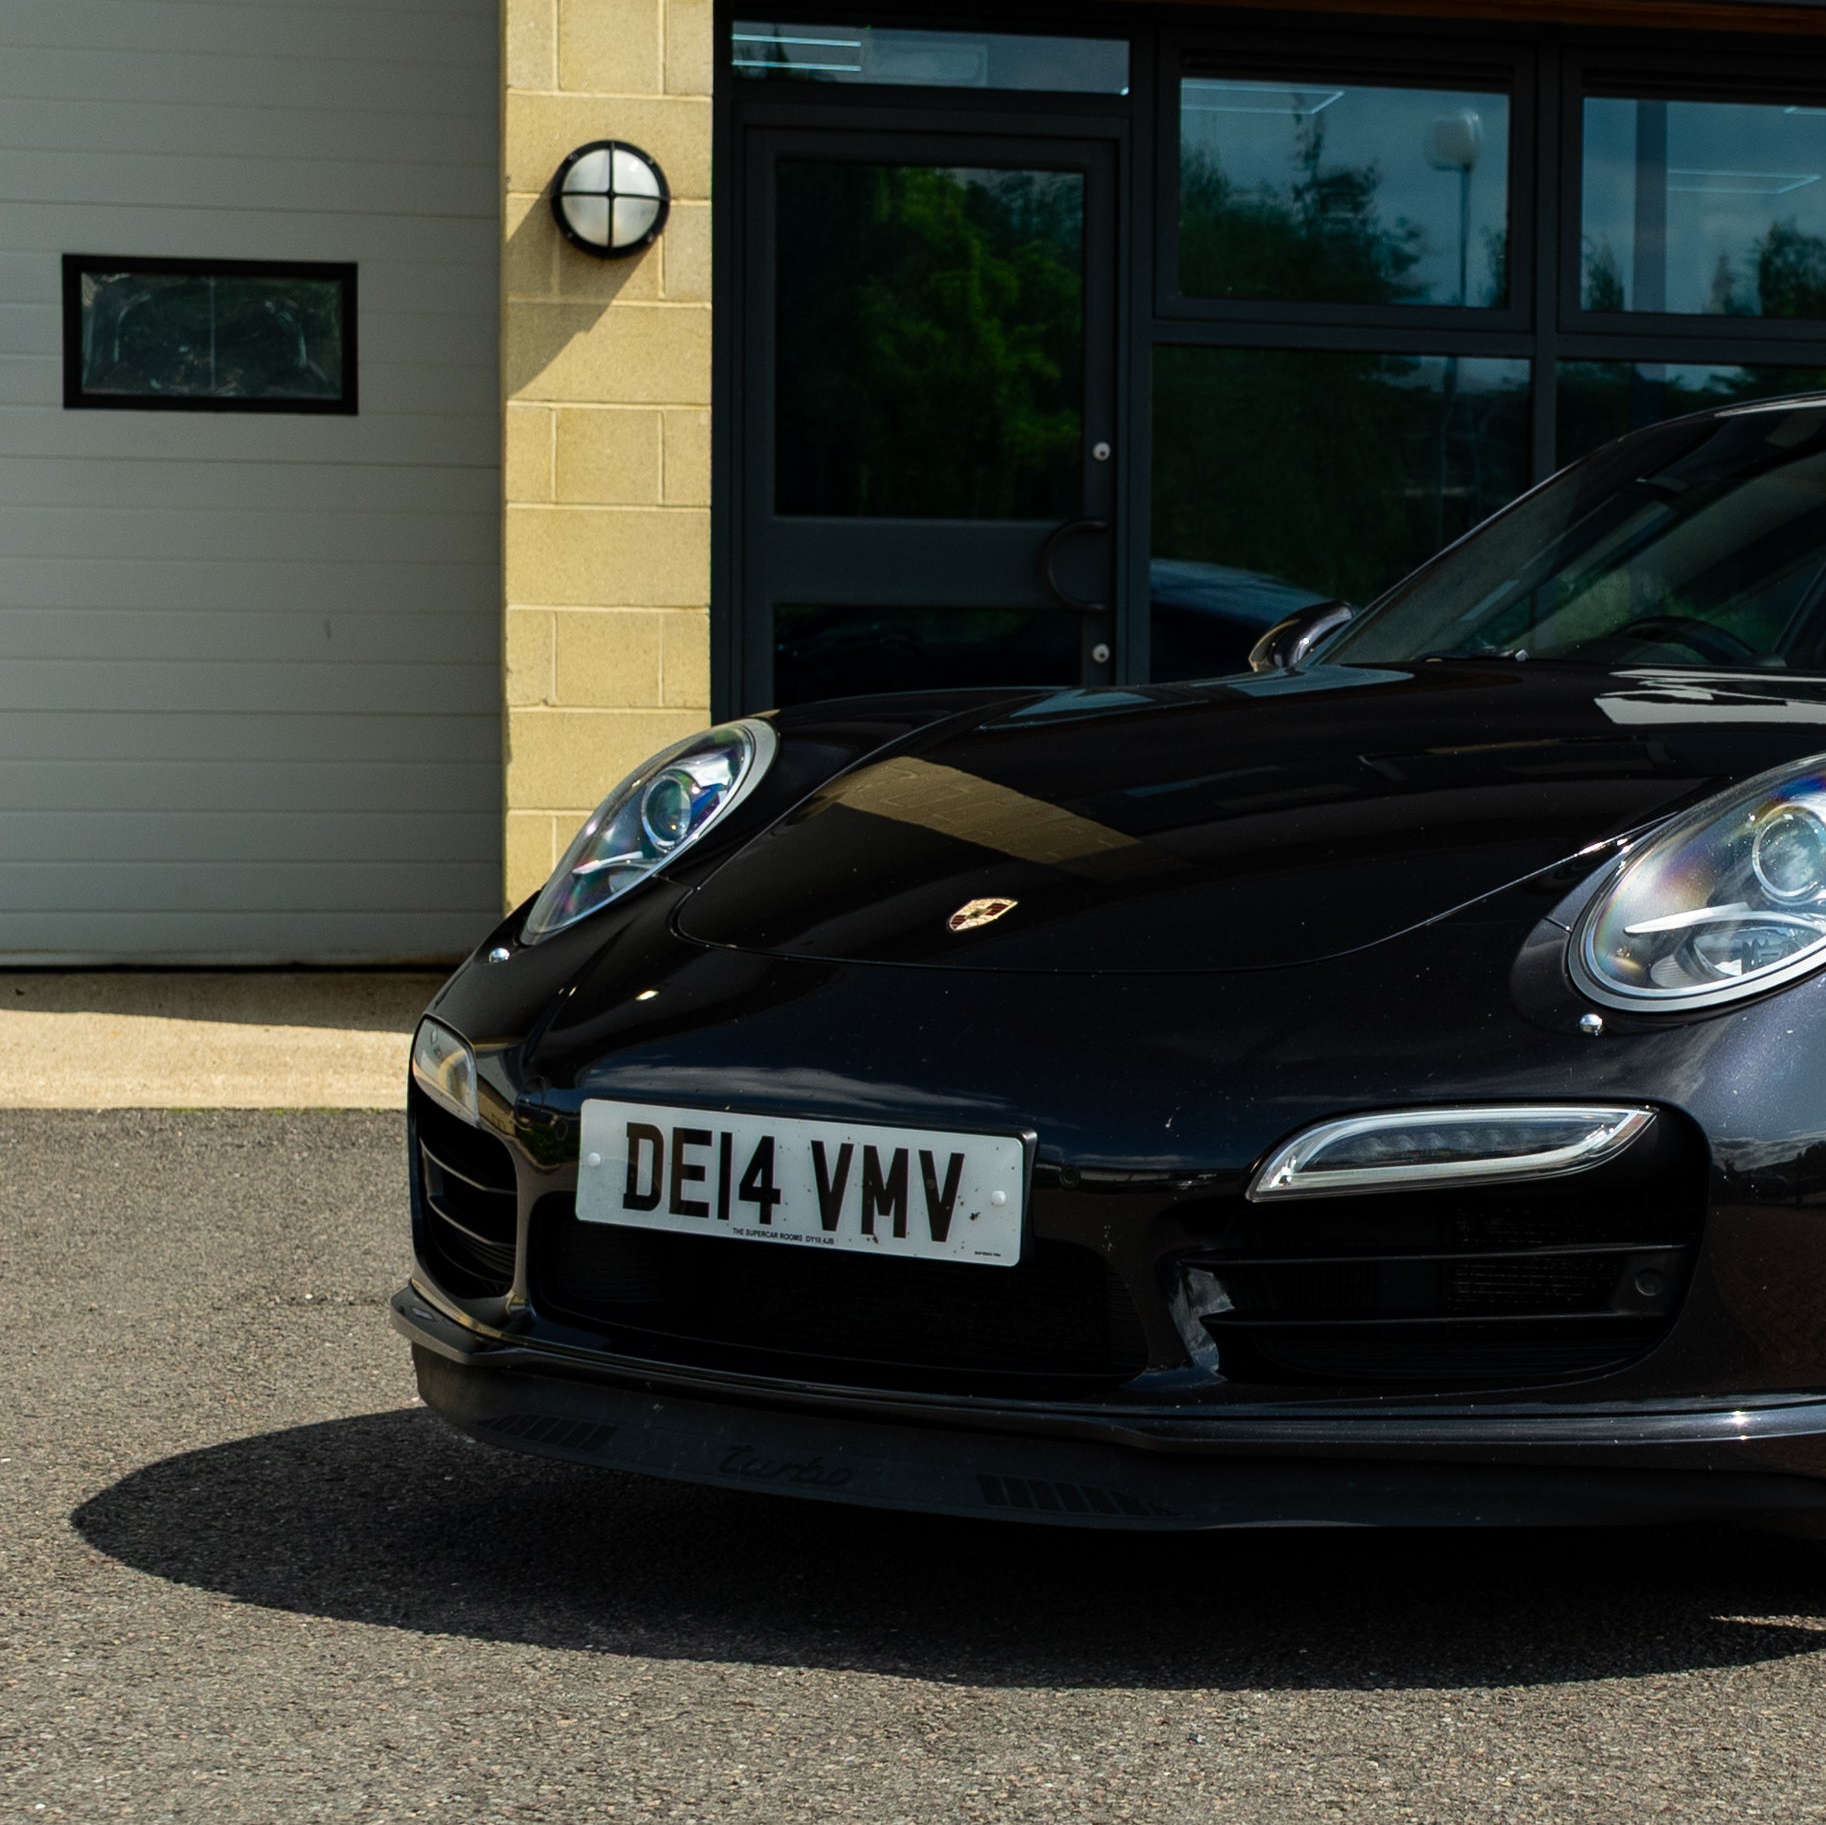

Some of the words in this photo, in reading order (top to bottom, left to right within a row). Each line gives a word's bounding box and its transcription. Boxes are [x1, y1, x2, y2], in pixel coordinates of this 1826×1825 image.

[621, 1121, 782, 1226] DE14
[810, 1139, 966, 1243] VMV
[732, 1227, 745, 1235] THE
[745, 1228, 779, 1239] SUPERCAR
[718, 1444, 856, 1487] Turbo
